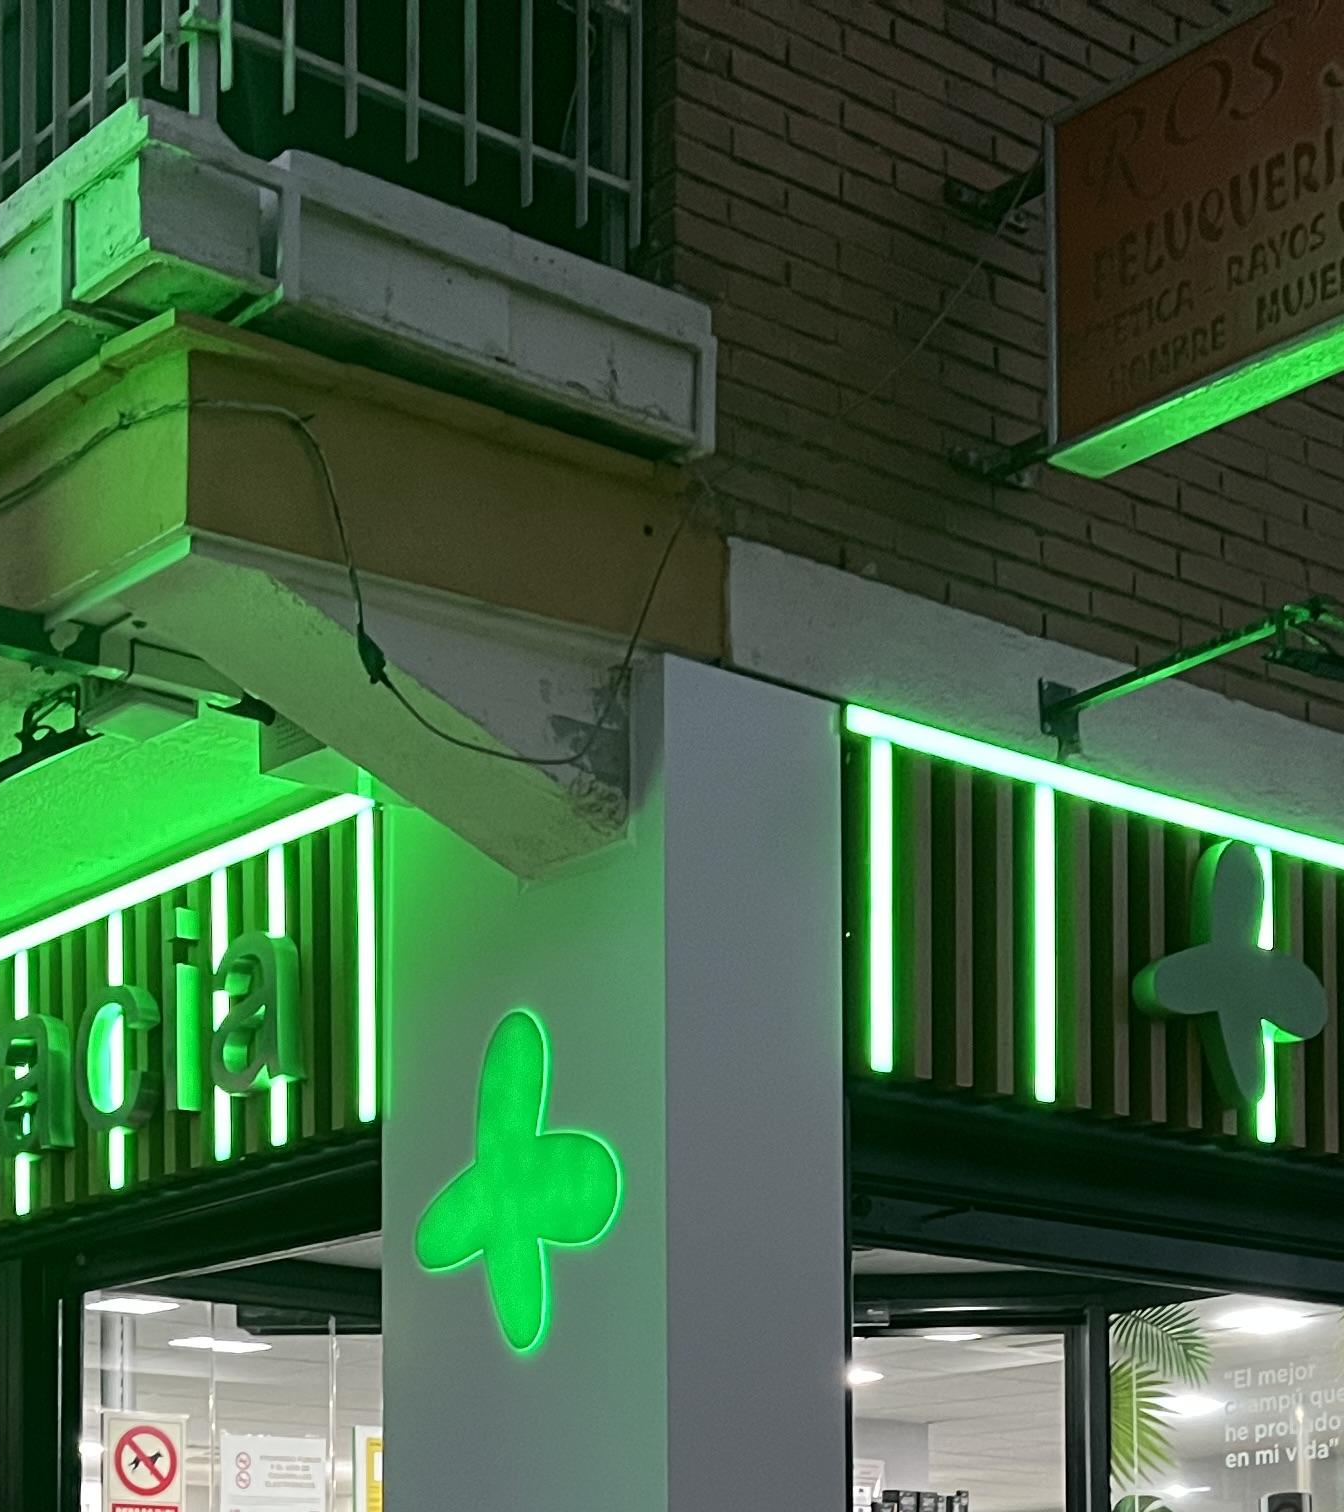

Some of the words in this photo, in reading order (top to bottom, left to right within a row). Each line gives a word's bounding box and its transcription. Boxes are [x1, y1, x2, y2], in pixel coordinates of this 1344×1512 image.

[1226, 212, 1326, 291] RAYOS
[1258, 1362, 1316, 1386] mejor
[1224, 1423, 1249, 1443] he
[1225, 1450, 1250, 1469] en
[1255, 1443, 1280, 1466] mi
